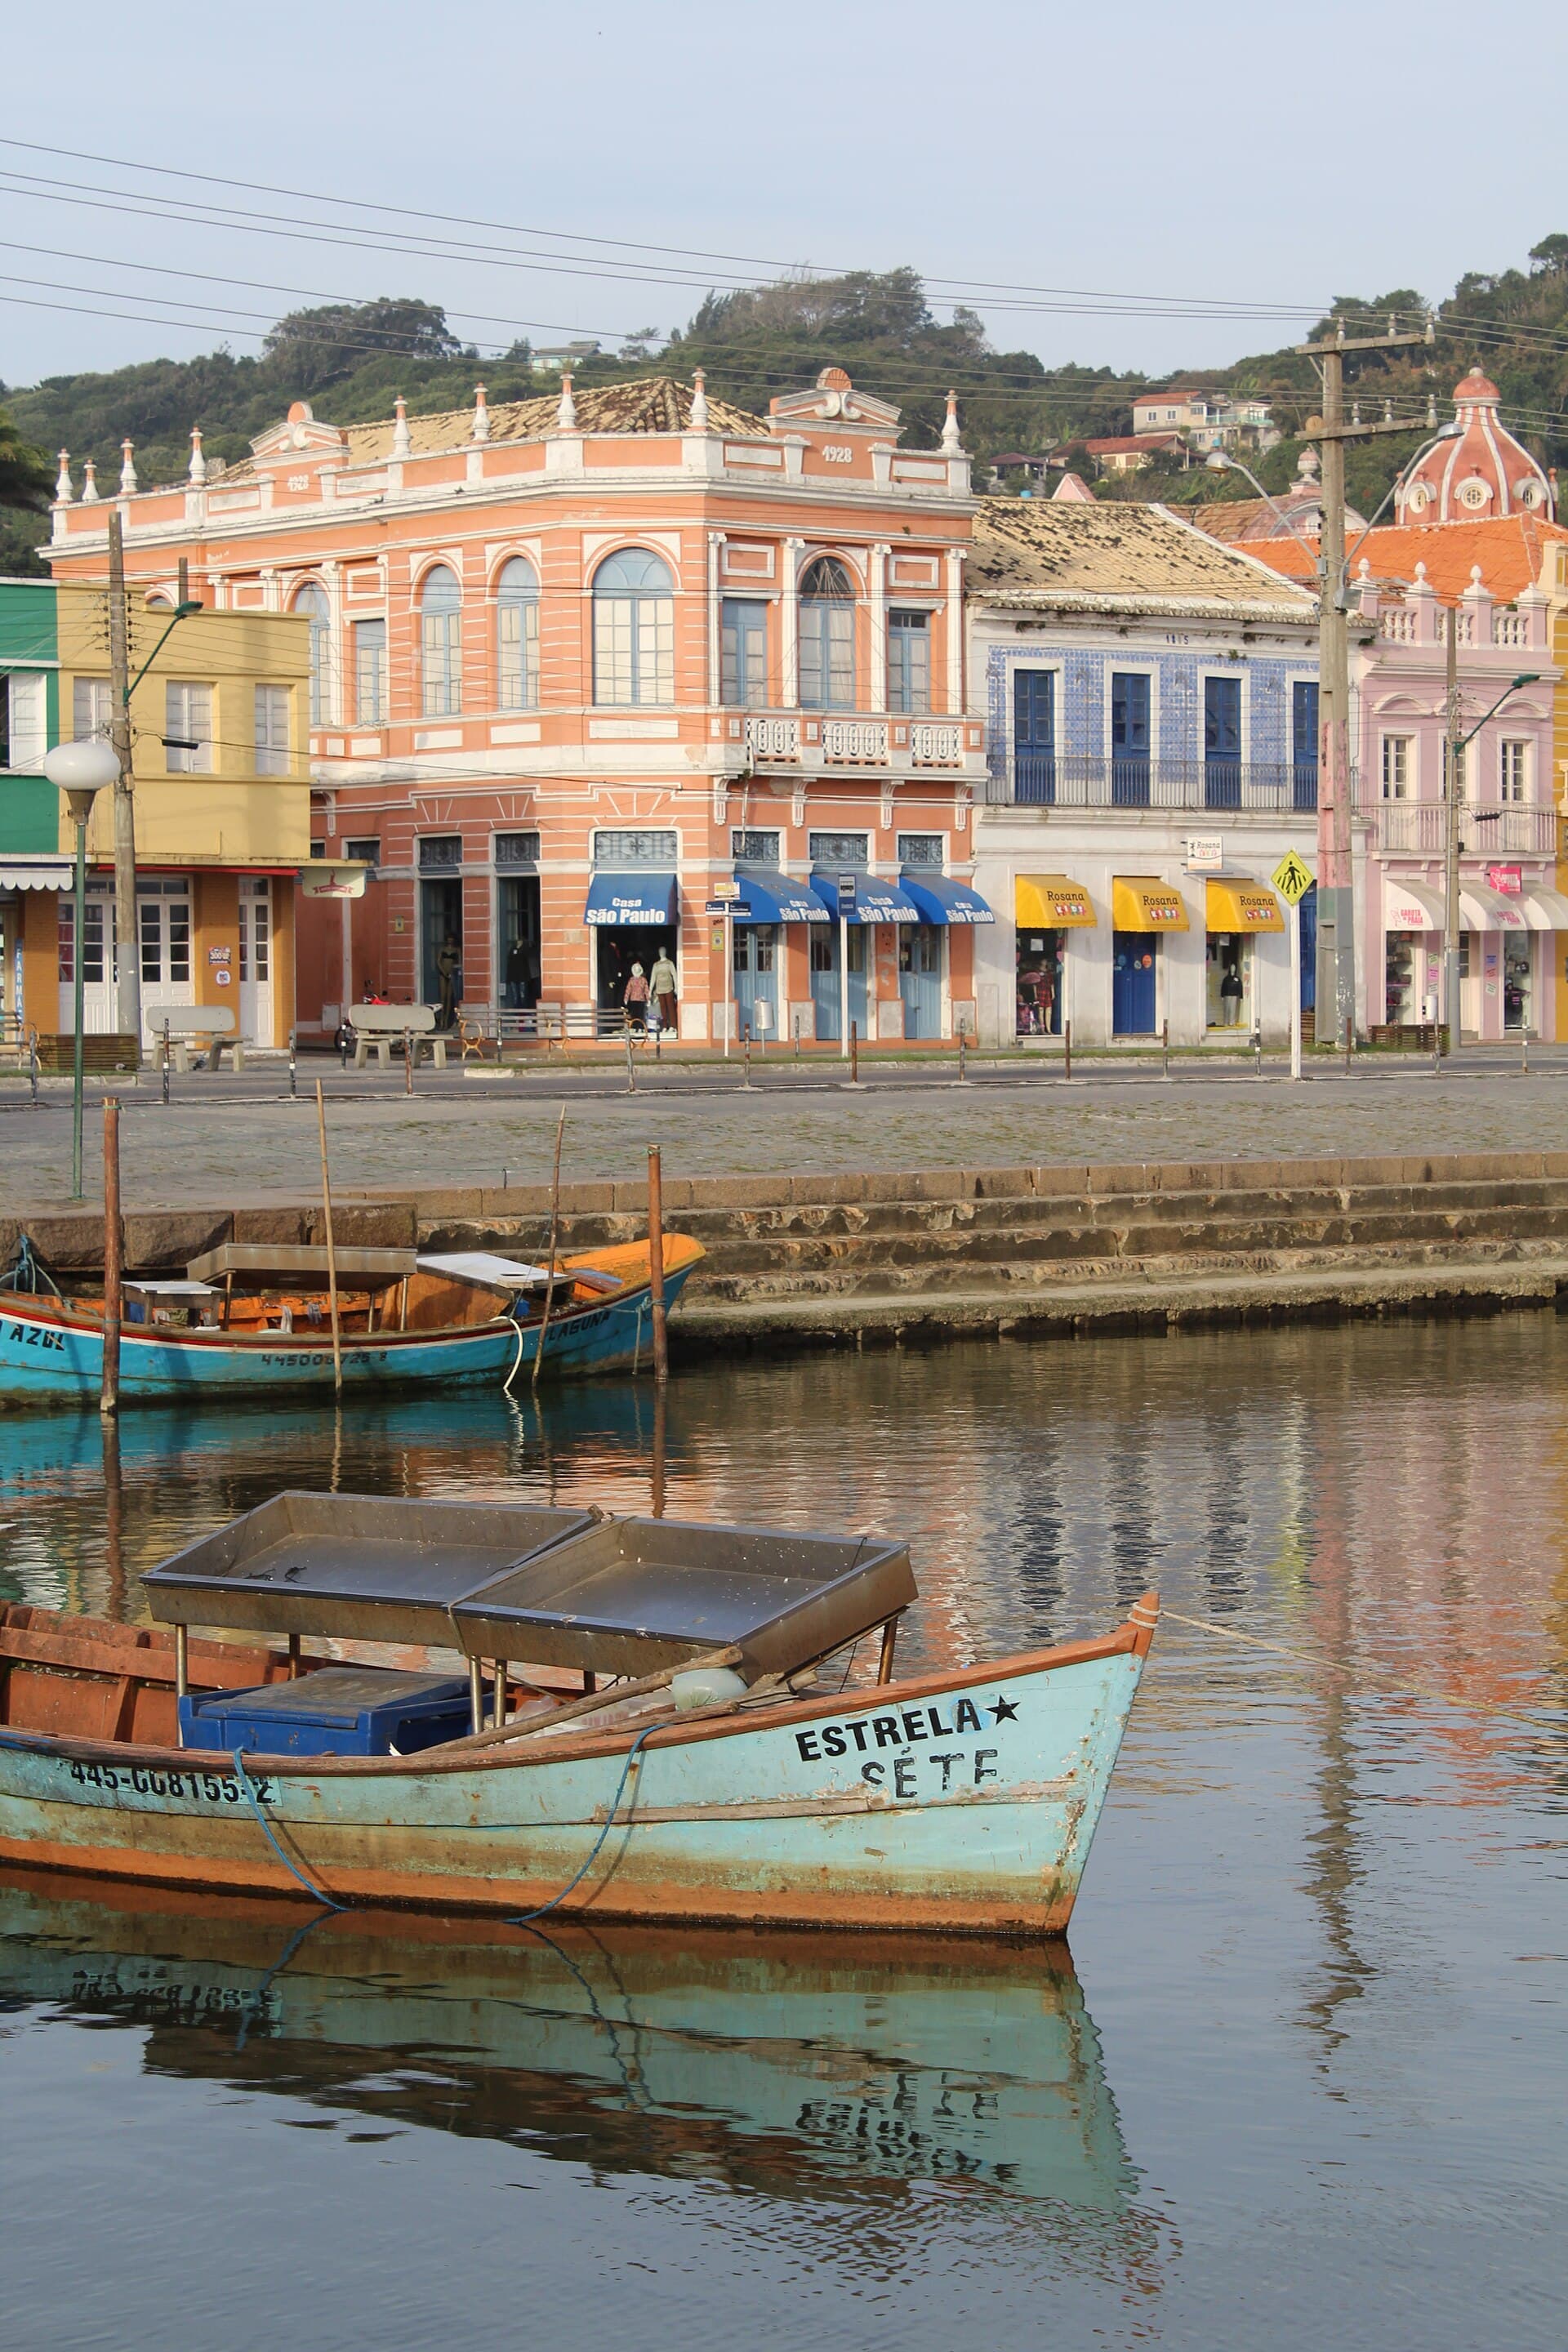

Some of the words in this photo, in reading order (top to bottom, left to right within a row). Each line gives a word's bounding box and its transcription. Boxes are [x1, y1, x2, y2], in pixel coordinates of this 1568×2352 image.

[822, 445, 852, 462] 1928
[612, 898, 642, 907] Casa
[1047, 891, 1085, 901] Rosana
[1143, 895, 1178, 906] Rosana
[1240, 895, 1274, 906] Rosana
[586, 908, 617, 923] São
[620, 908, 666, 923] Paulo
[779, 908, 800, 920] São
[799, 908, 830, 920] Paulo
[858, 906, 882, 921] São
[881, 906, 919, 921] Paulo
[946, 909, 966, 922] São
[964, 909, 994, 922] Paulo
[549, 1311, 611, 1341] LAGUNA
[9, 1324, 65, 1352] AZUL
[795, 1697, 982, 1762] ESTRELA
